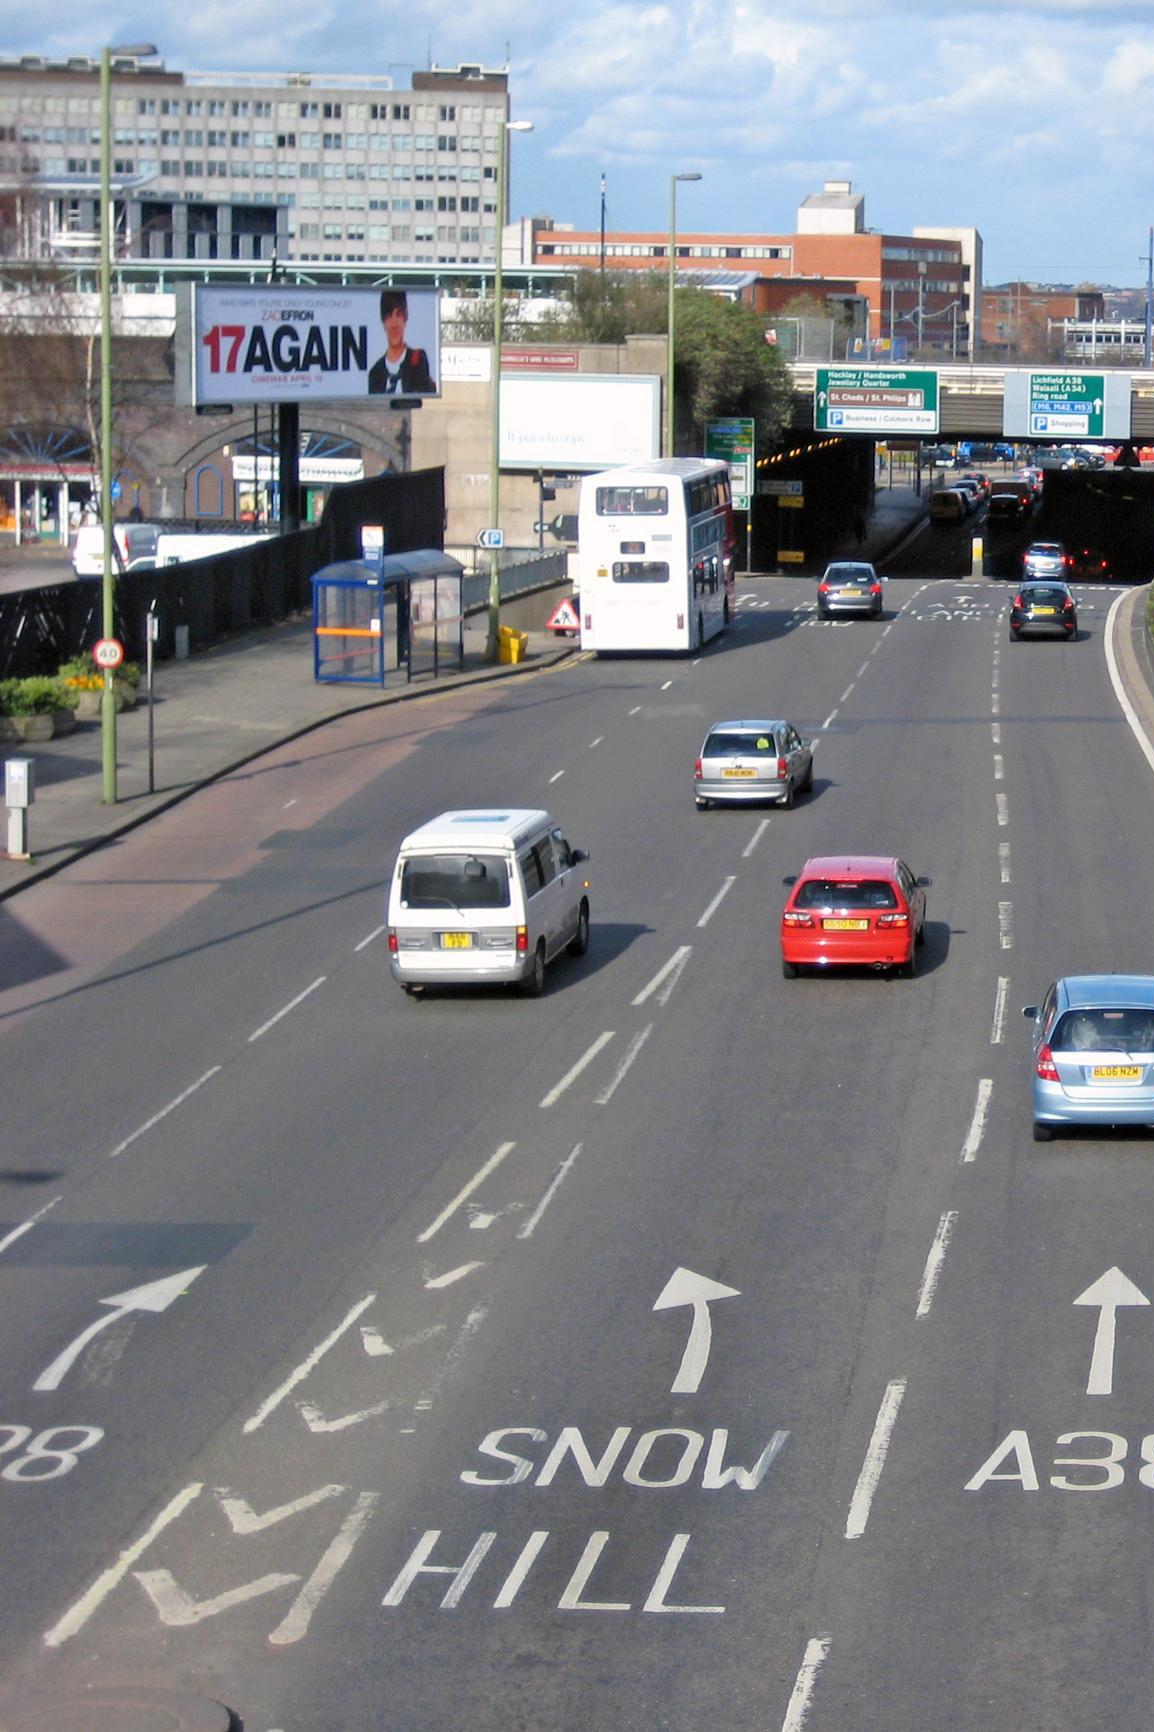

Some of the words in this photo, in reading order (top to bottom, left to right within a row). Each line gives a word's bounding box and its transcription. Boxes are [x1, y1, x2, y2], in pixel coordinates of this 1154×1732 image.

[828, 371, 856, 380] Hockley
[1061, 384, 1086, 392] (A34)
[1051, 420, 1085, 428] Shopping
[490, 532, 500, 544] P
[100, 648, 118, 658] 40
[460, 1426, 790, 1490] SNOW
[380, 1530, 726, 1613] HILL
